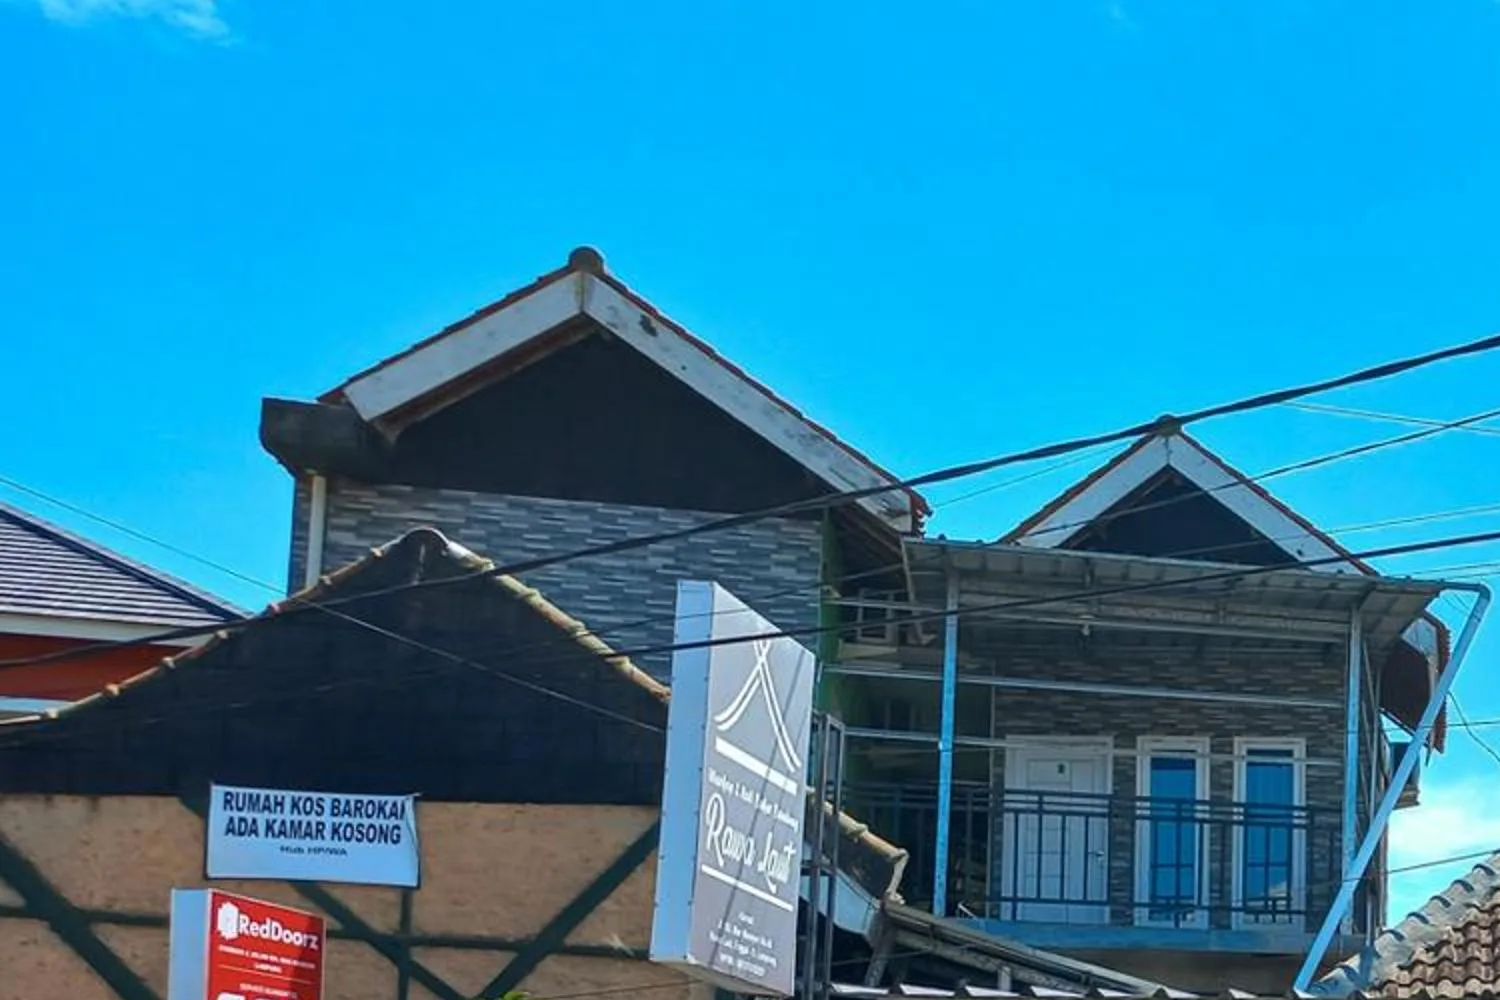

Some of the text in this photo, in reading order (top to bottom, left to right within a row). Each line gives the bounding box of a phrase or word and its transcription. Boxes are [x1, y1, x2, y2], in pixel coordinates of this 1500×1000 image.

[223, 791, 285, 815] RUMAH
[290, 796, 325, 816] KOS
[224, 816, 401, 845] ADA KAMAR KOSONG
[705, 792, 797, 894] Rawa Laut
[239, 914, 319, 950] RedDoorz
